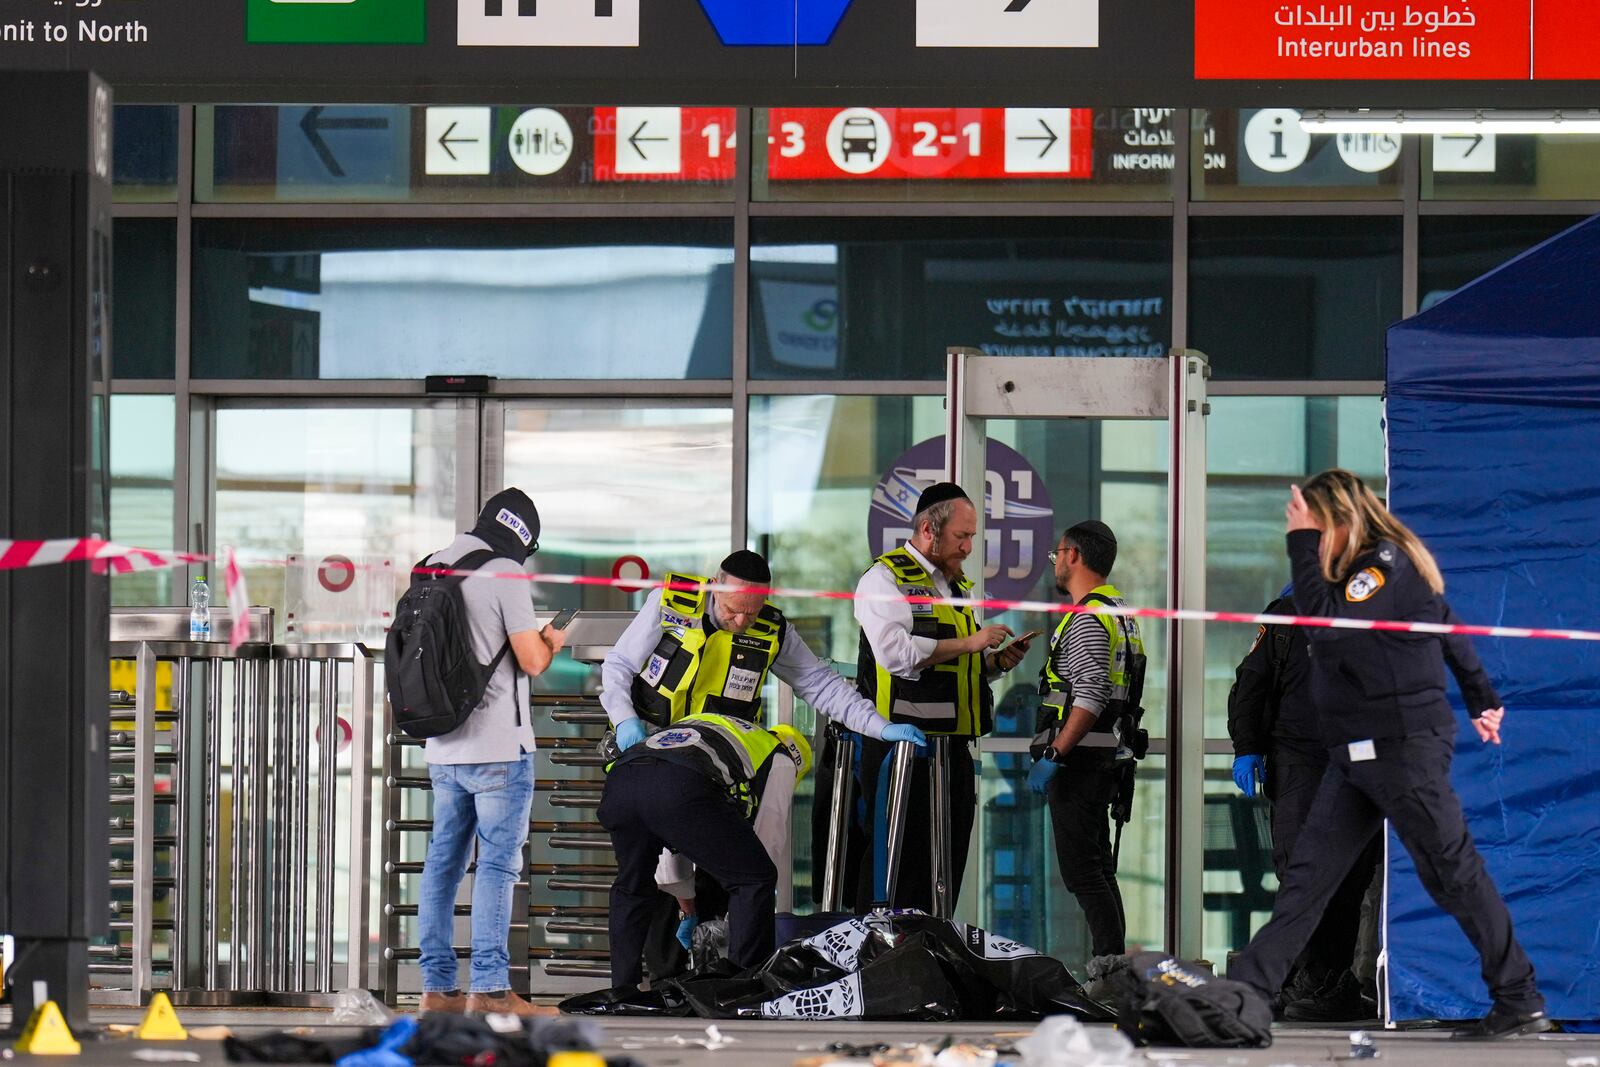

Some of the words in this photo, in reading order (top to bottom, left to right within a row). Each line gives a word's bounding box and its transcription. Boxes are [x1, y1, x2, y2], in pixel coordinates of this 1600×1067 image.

[0, 20, 34, 42] nit
[43, 21, 68, 42] to
[78, 20, 148, 42] North
[1274, 5, 1352, 31] البلدات
[1360, 11, 1395, 32] بين
[1402, 5, 1476, 33] خطوط
[1277, 36, 1403, 58] Interurban
[1412, 36, 1471, 58] lines
[911, 121, 982, 157] 2-1
[500, 511, 530, 541] משטרה
